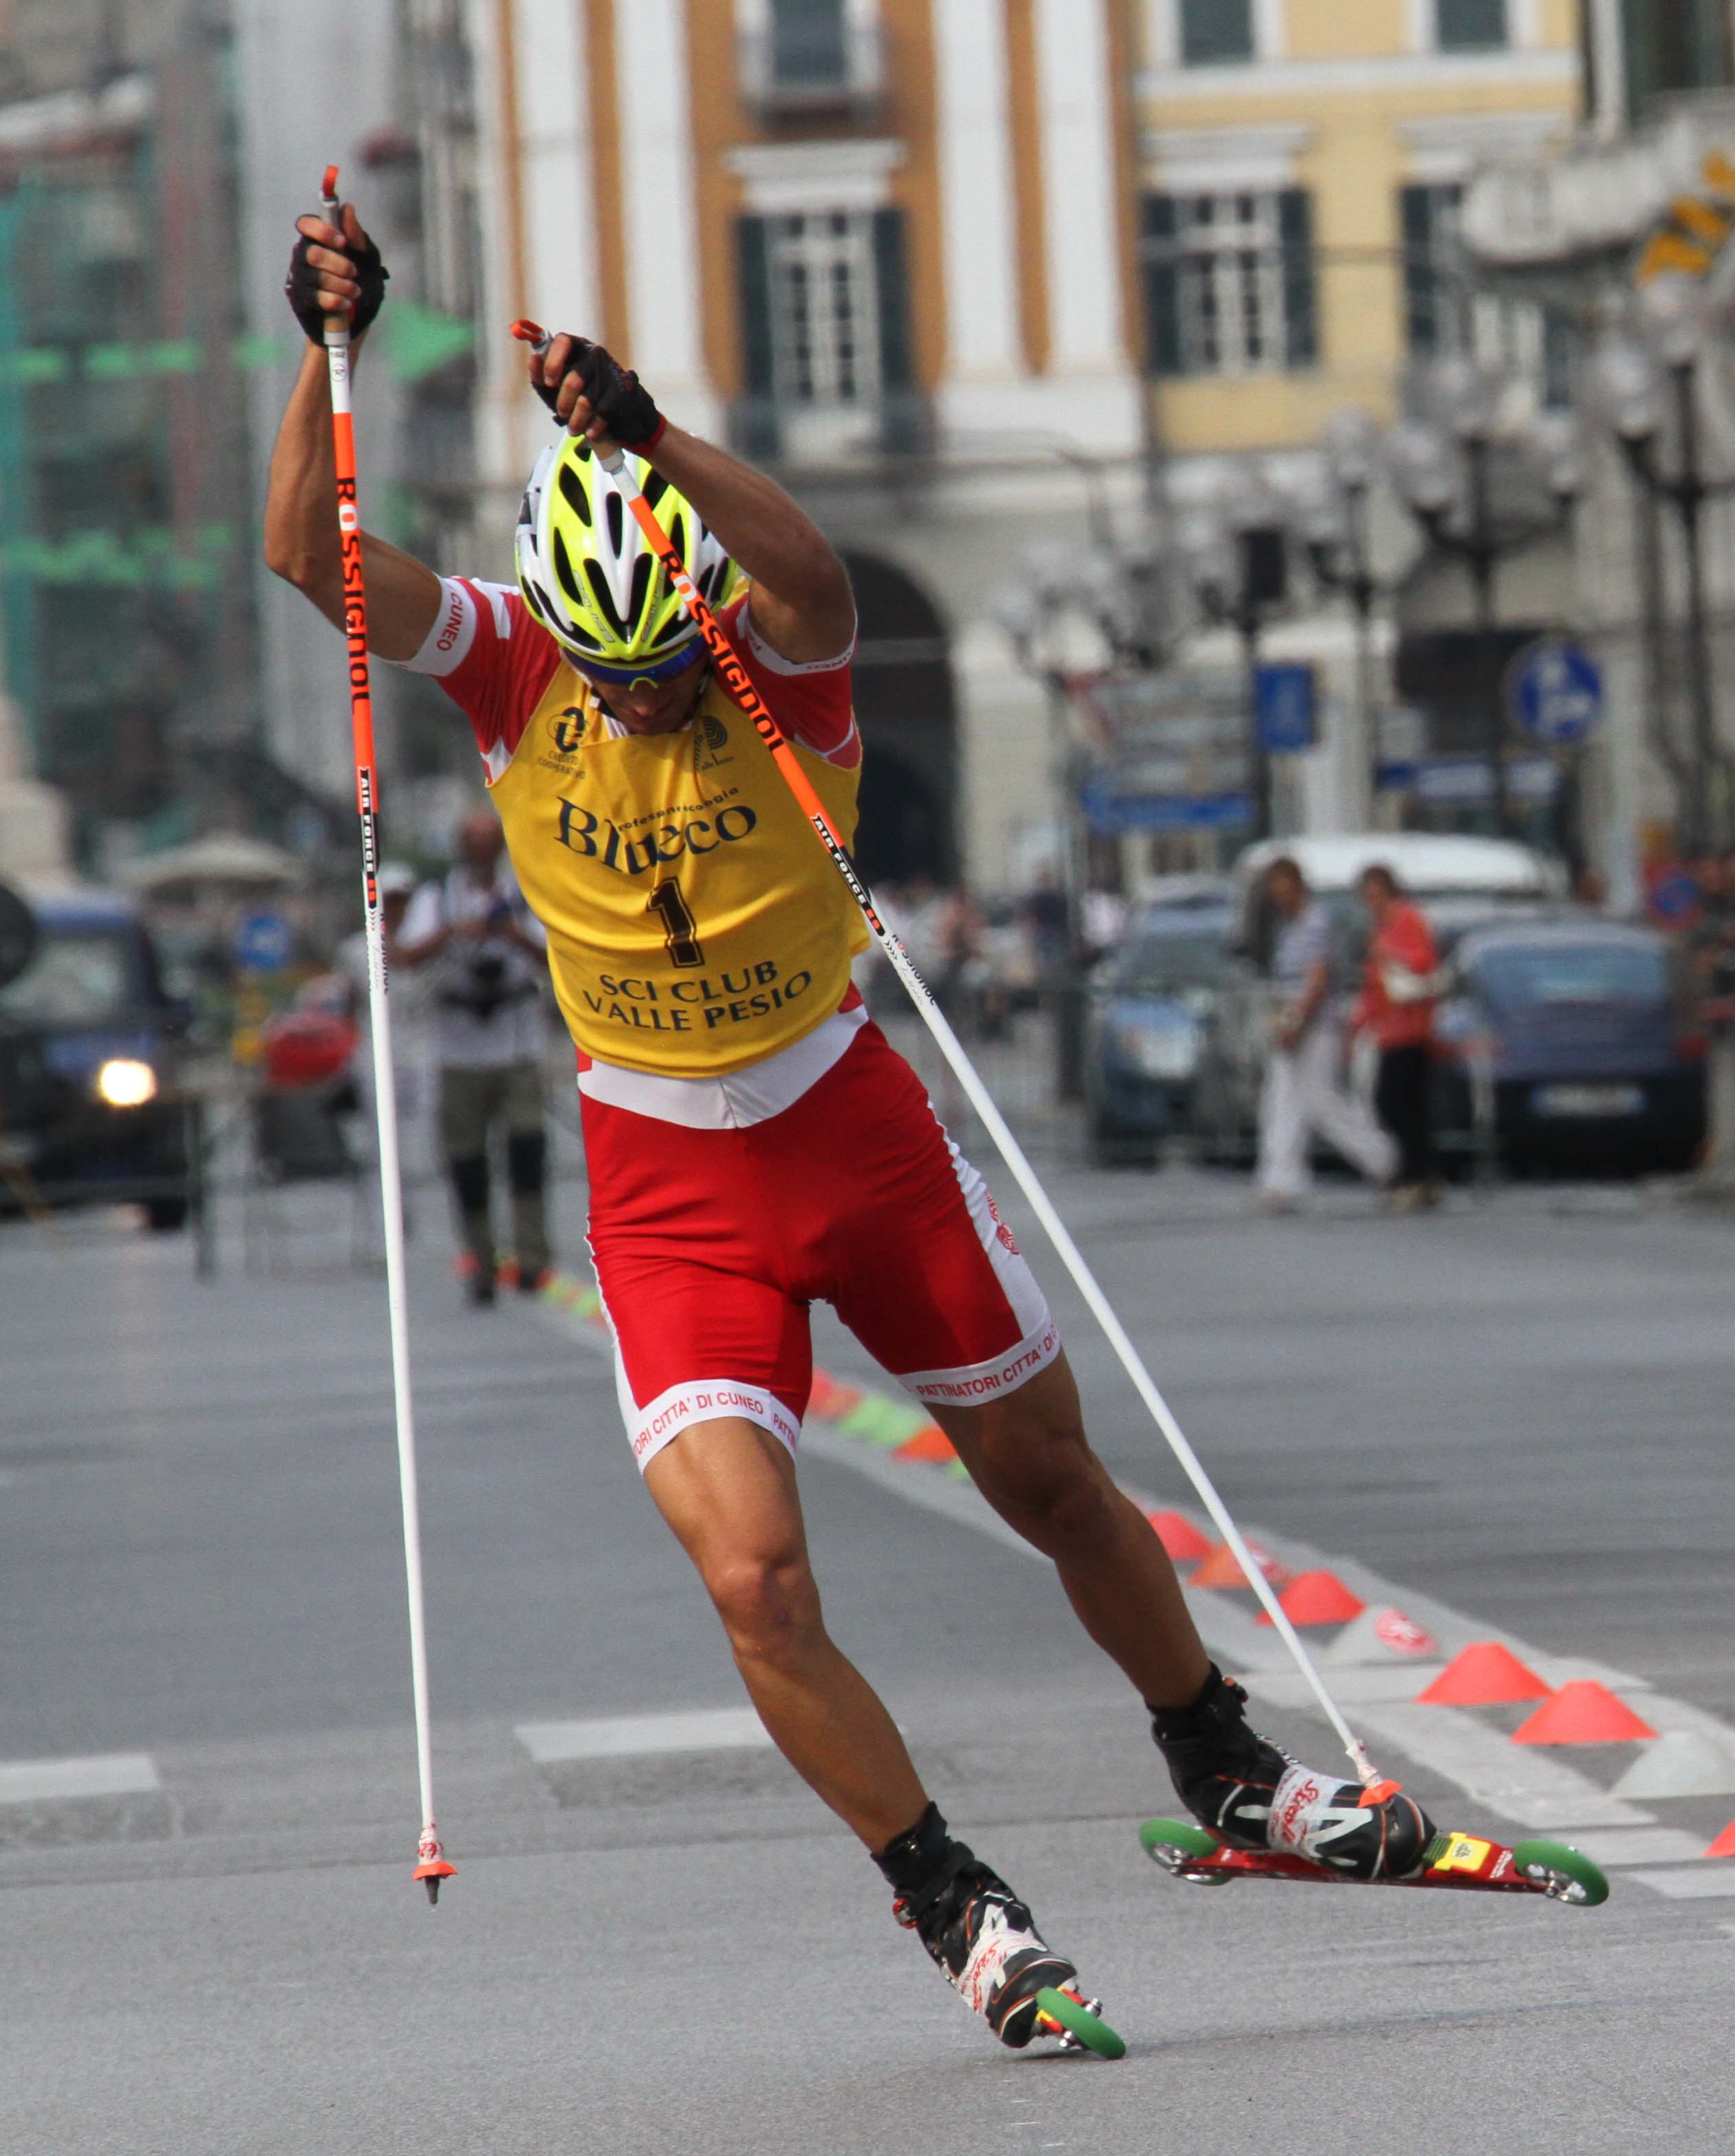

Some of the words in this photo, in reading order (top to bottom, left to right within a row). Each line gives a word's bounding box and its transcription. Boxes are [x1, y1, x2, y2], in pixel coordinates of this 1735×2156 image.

[336, 477, 370, 712] ROSSIGNOL
[436, 592, 463, 652] CUNEO
[659, 550, 786, 753] ROSSIGNOL
[553, 795, 757, 874] Blueco
[814, 819, 835, 848] AIR
[833, 852, 867, 904] FORCE
[646, 875, 705, 969] 1
[582, 989, 692, 1031] VALLE
[703, 970, 812, 1029] PESIO
[599, 974, 658, 1001] SCI
[670, 960, 777, 1003] CLUB
[916, 1374, 1001, 1397] PATTINATORI
[1003, 1345, 1042, 1383] CITTA'
[652, 1397, 691, 1435] CITTA'
[696, 1394, 713, 1409] DI
[716, 1392, 765, 1416] CUNEO
